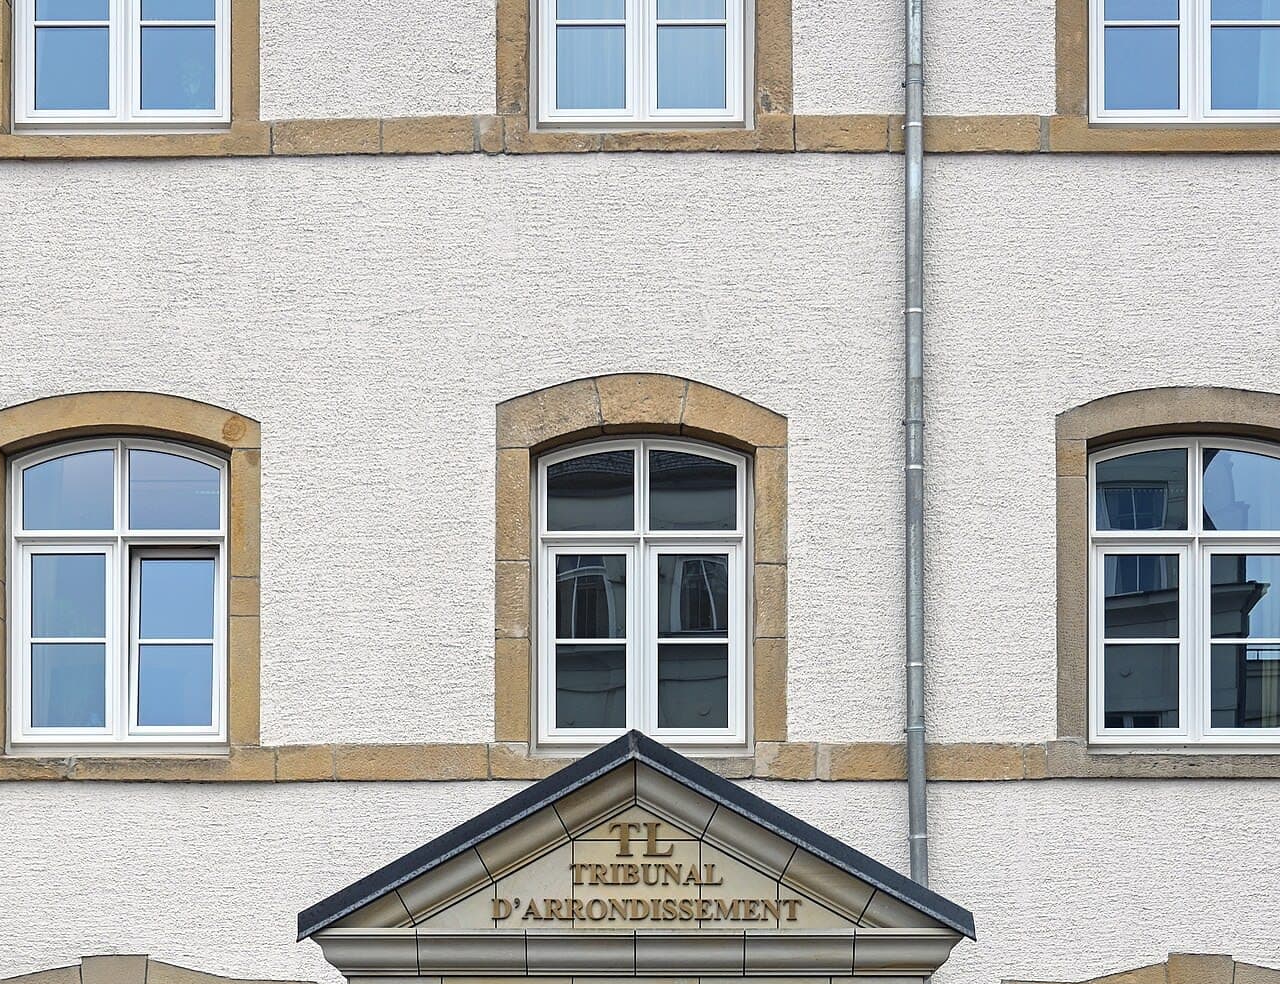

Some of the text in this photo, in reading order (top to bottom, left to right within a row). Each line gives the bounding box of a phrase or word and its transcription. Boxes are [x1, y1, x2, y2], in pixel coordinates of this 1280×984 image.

[609, 822, 674, 857] TL
[570, 863, 723, 885] TRIBUNAL
[491, 898, 802, 920] D'ARRONDISSEMENT
